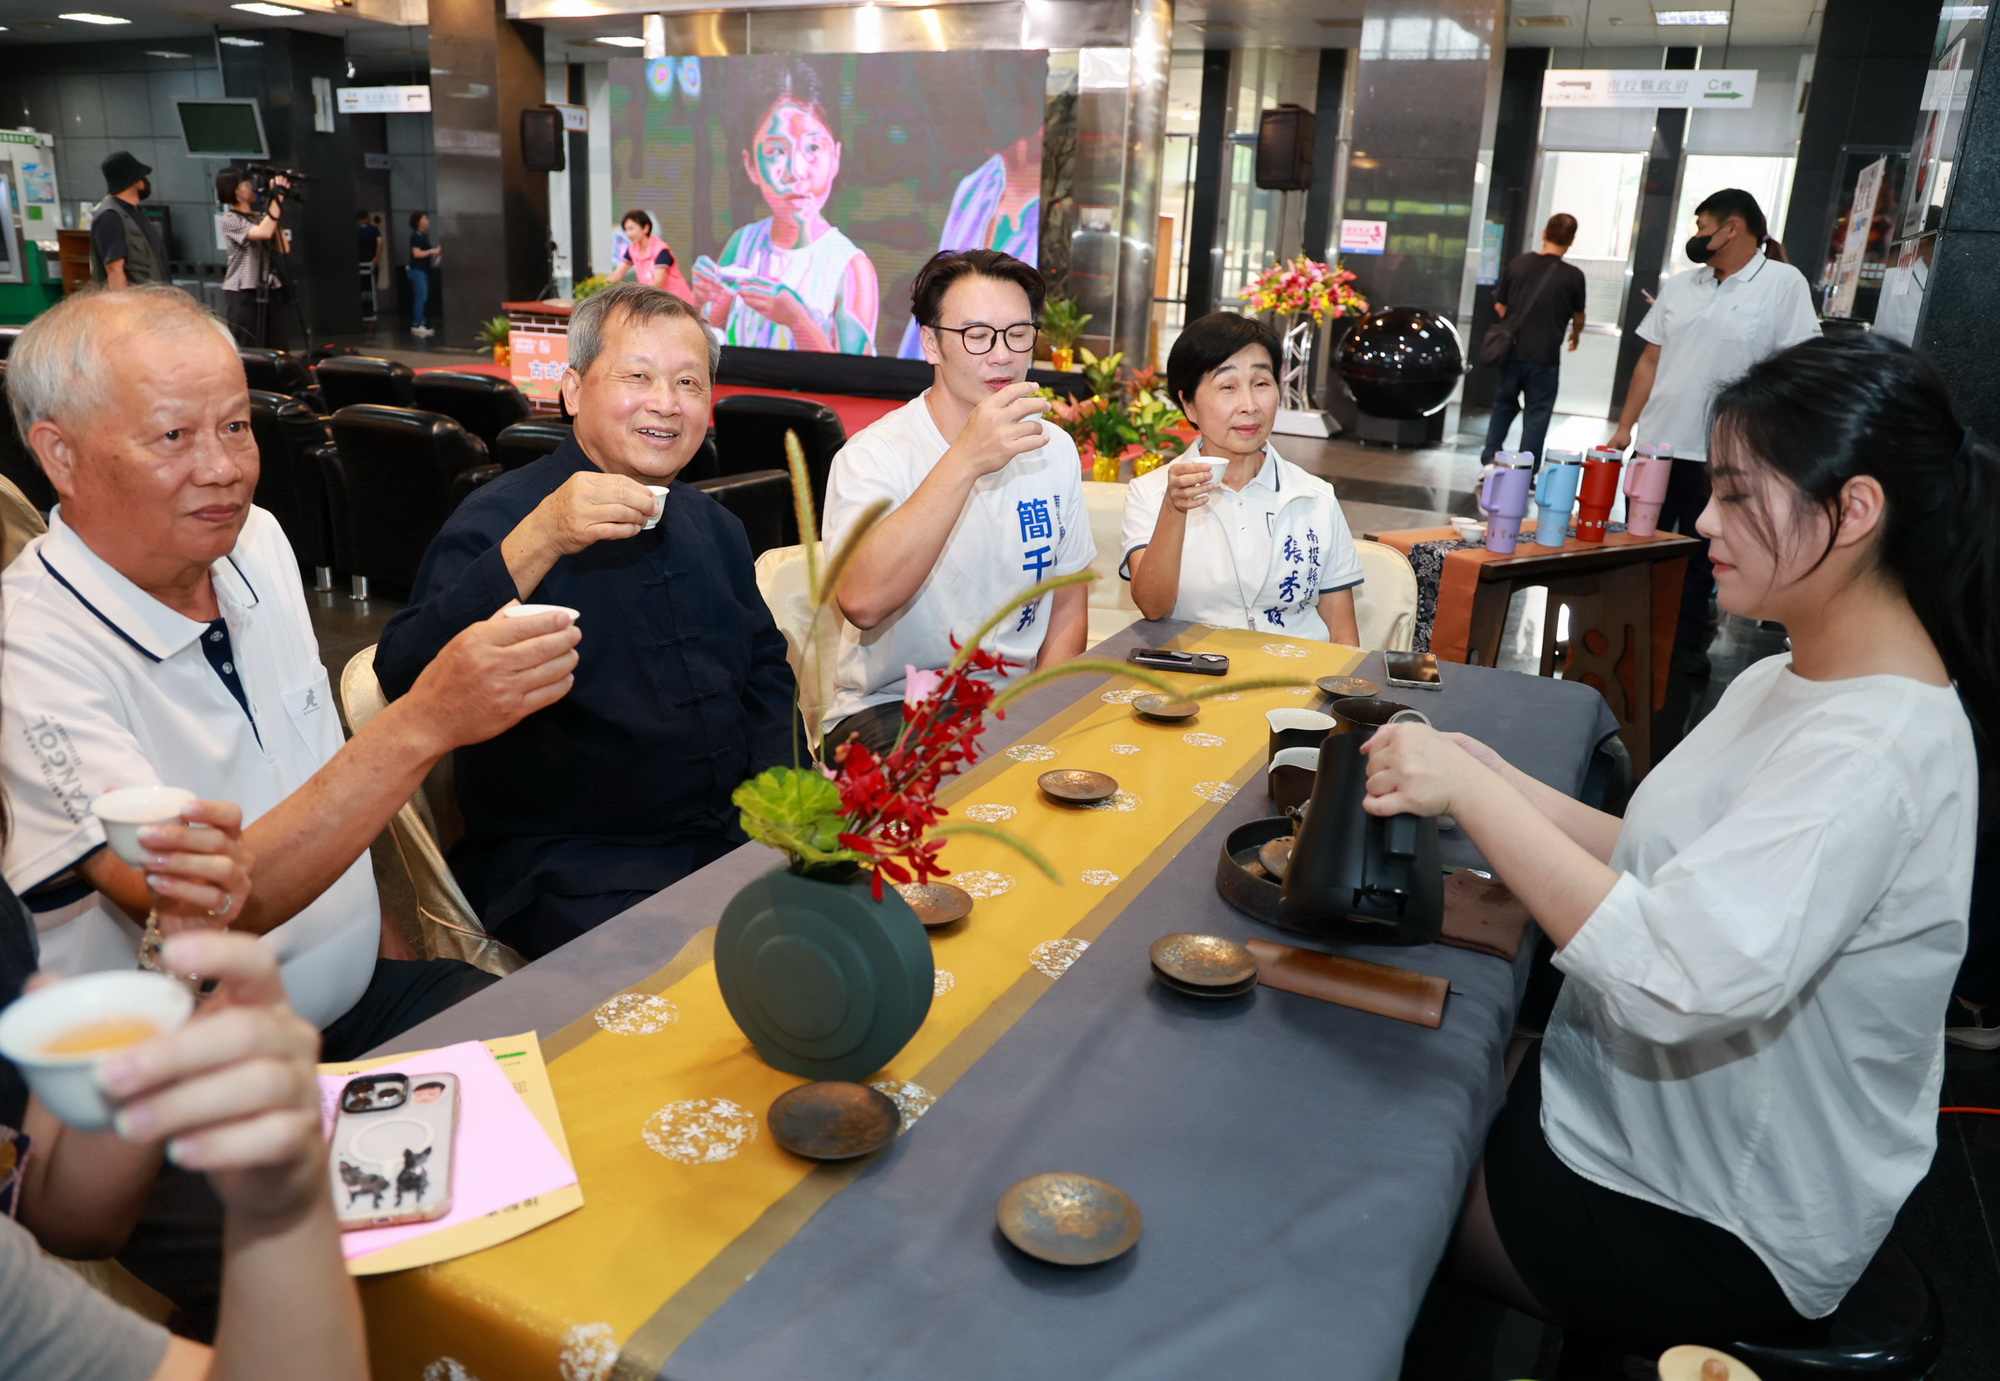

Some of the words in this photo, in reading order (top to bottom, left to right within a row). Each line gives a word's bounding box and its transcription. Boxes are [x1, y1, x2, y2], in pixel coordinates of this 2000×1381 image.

[1607, 78, 1689, 92] 南投縣政府
[529, 360, 569, 381] 古式
[31, 715, 94, 820] KANGOL
